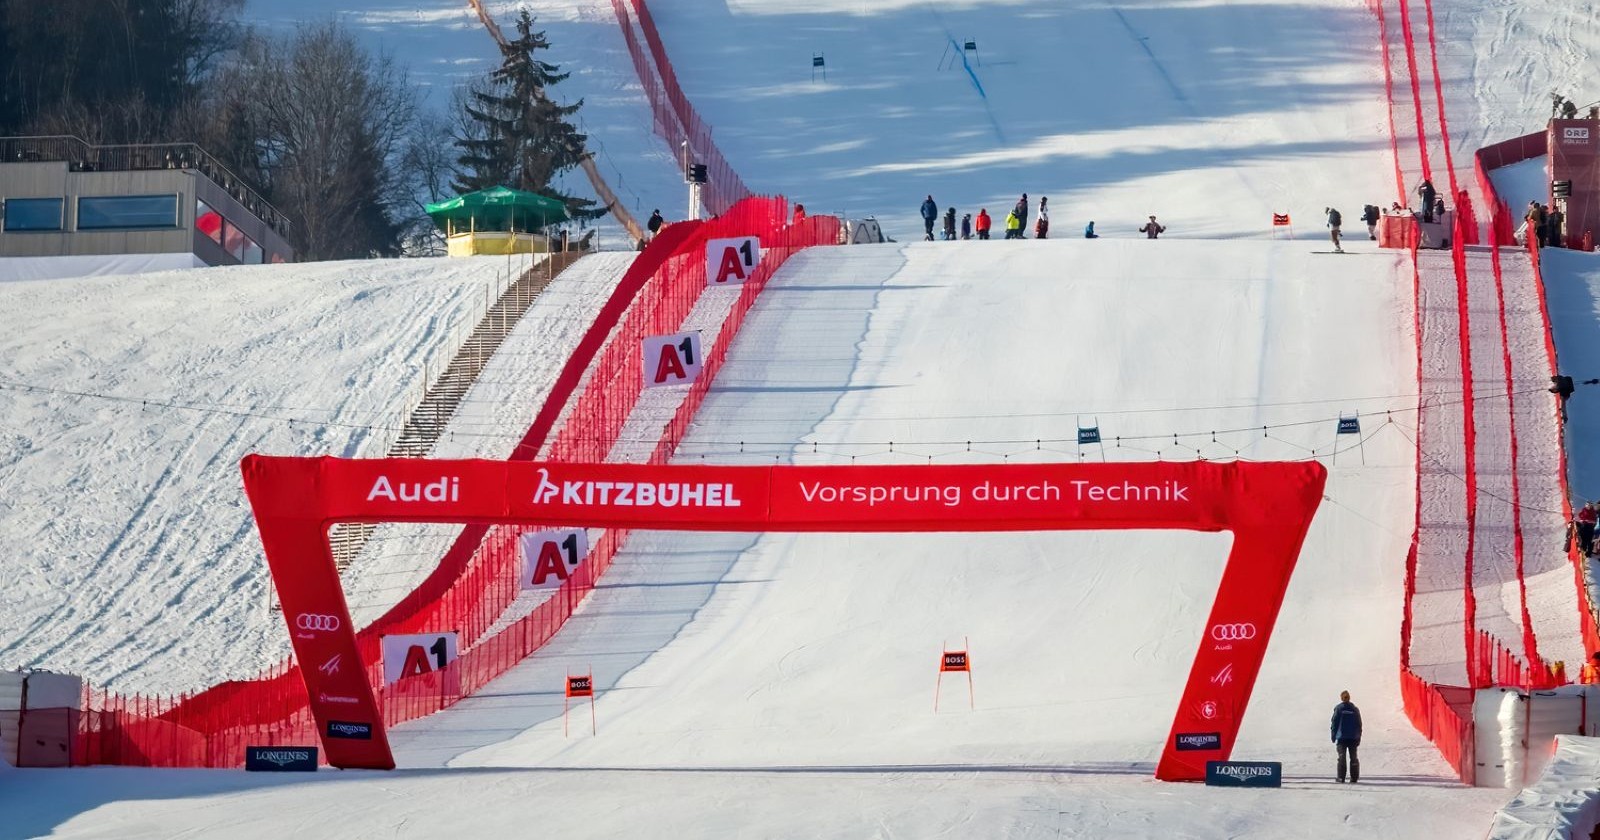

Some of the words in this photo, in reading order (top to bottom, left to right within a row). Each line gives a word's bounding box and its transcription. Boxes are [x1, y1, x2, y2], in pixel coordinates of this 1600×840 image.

[1566, 129, 1587, 137] ORF
[715, 240, 752, 282] A1
[654, 336, 694, 383] A1
[366, 475, 460, 502] Audi
[799, 480, 961, 507] Vorsprung
[971, 480, 1060, 501] durch
[1070, 480, 1190, 502] Technik
[531, 533, 578, 585] A1
[397, 636, 448, 692] A1
[331, 724, 368, 732] LONGINES
[1180, 735, 1218, 744] LONGINES
[256, 751, 308, 760] LONGINES
[1216, 766, 1271, 775] LONGINES
